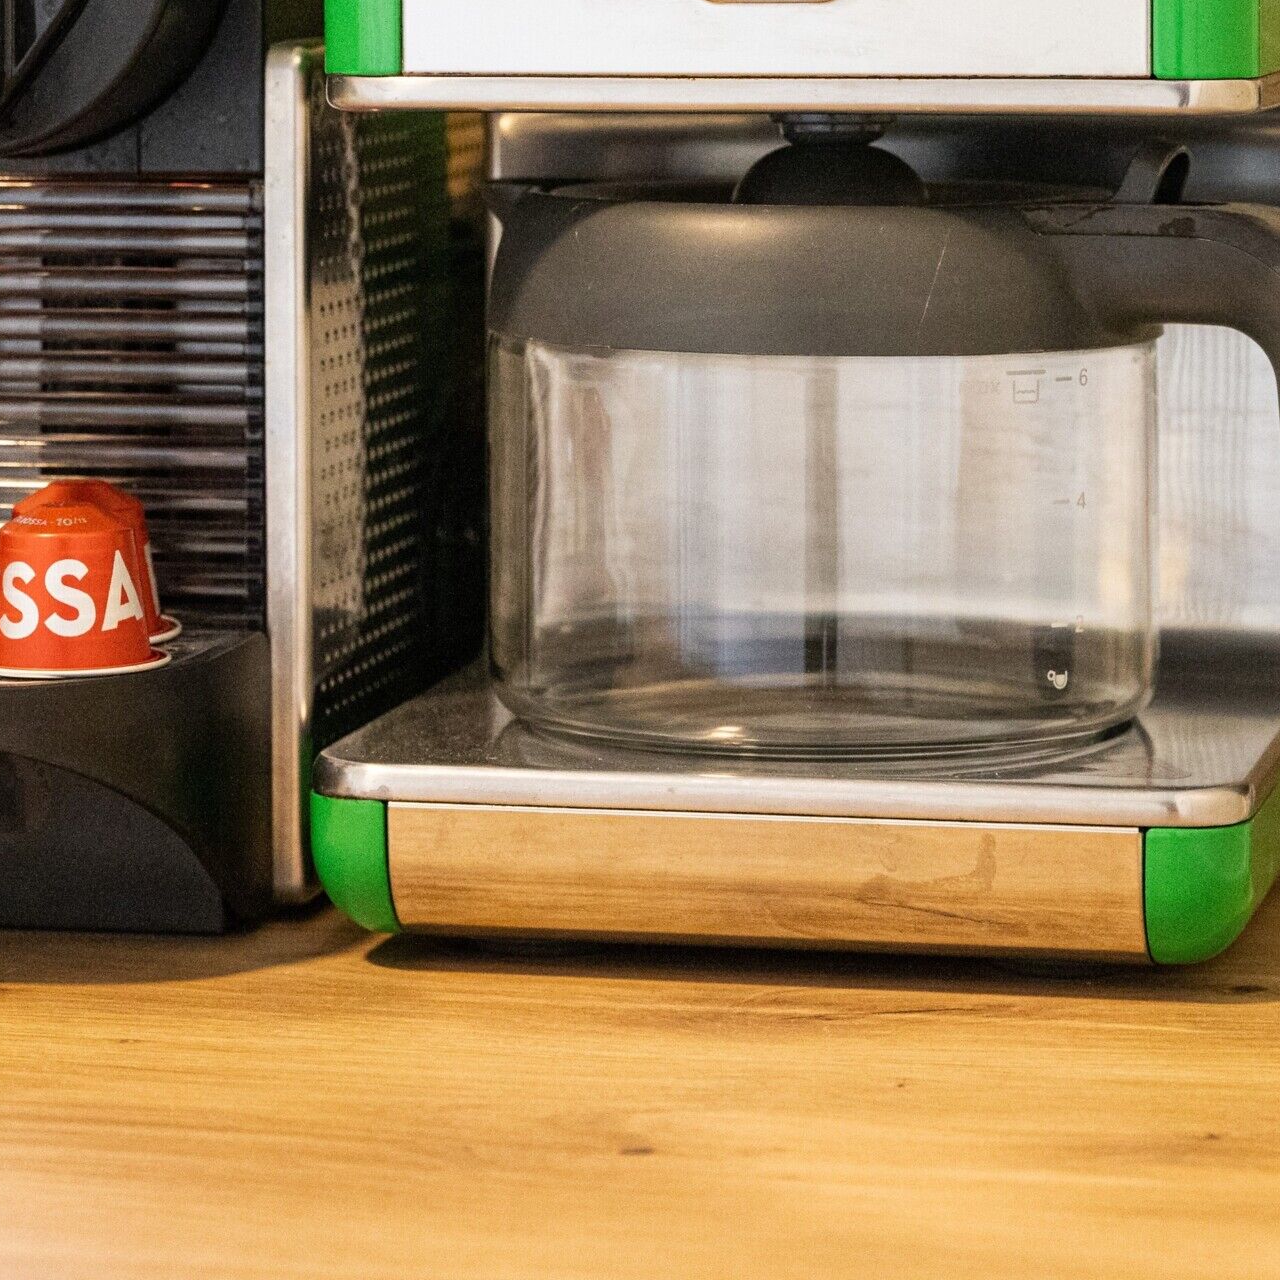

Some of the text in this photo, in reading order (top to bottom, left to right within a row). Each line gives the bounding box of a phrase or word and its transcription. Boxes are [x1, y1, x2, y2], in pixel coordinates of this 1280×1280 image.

[1078, 368, 1088, 386] 6
[1076, 492, 1087, 510] 4
[1075, 614, 1085, 633] 2
